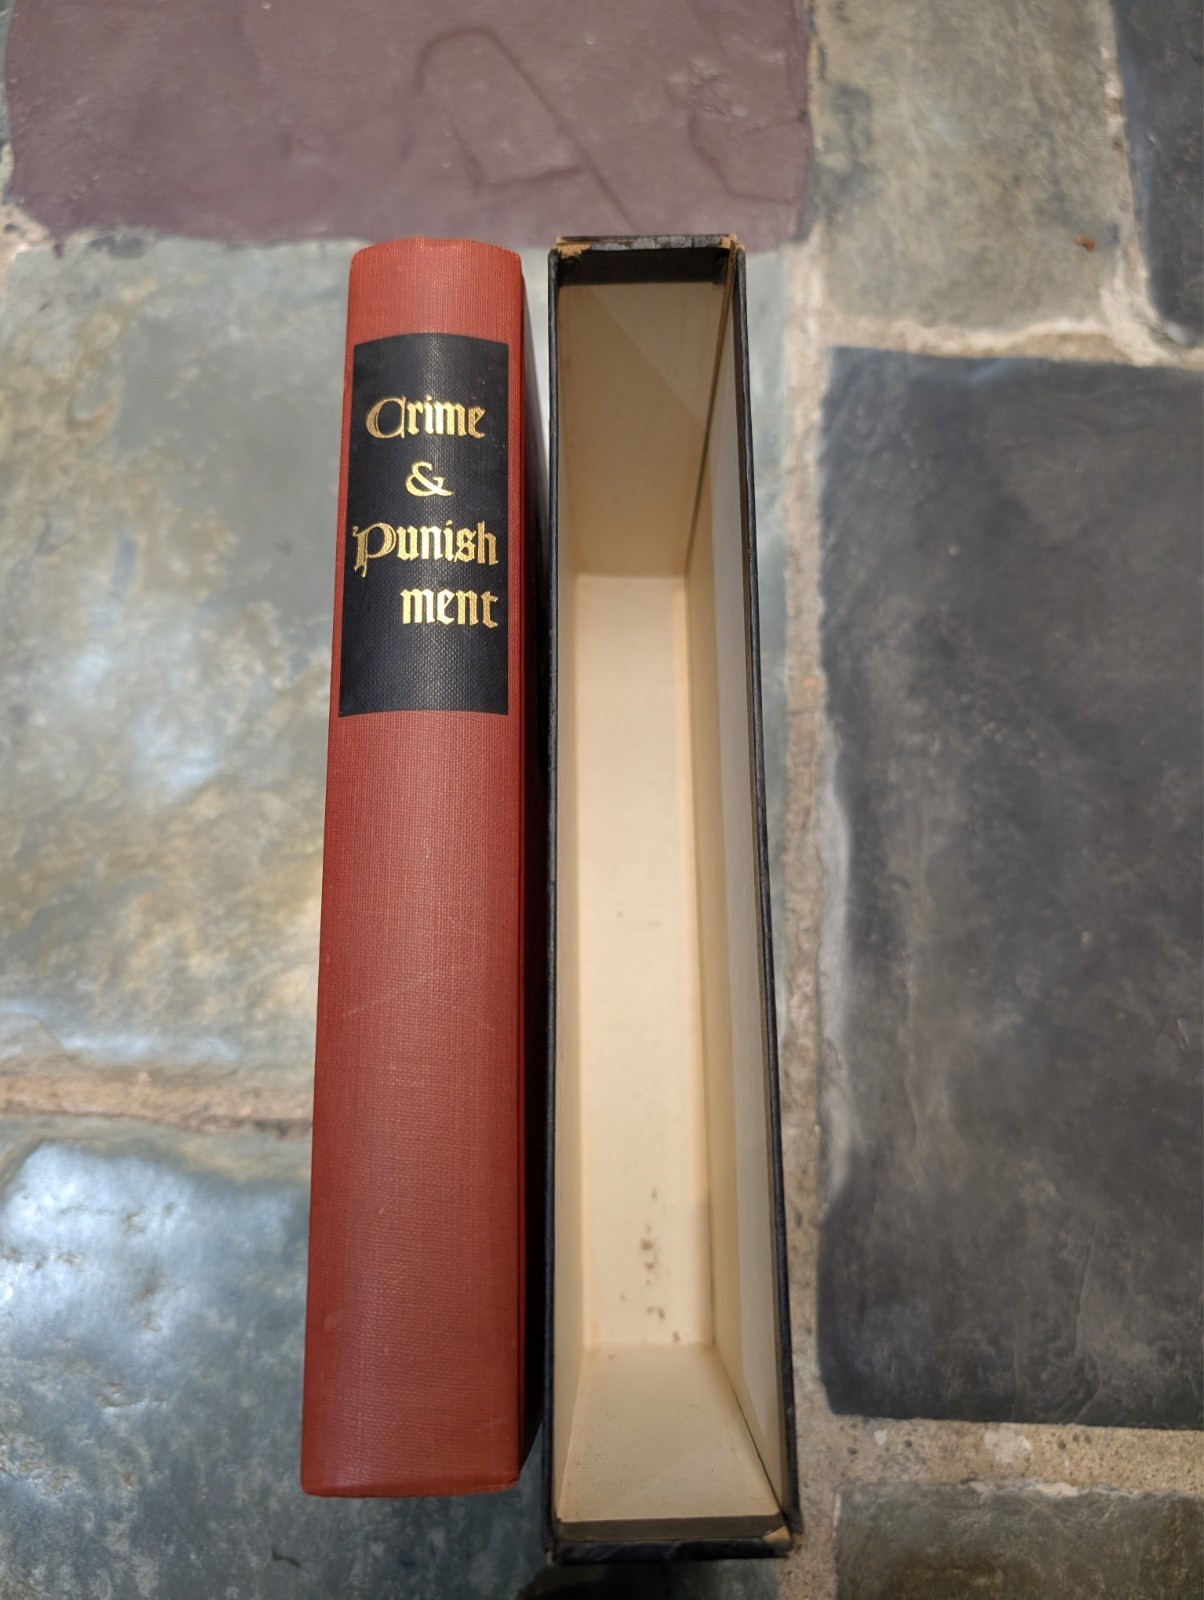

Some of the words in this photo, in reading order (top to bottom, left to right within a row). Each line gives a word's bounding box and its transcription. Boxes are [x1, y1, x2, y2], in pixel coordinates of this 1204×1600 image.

[365, 395, 486, 439] Crime
[406, 460, 454, 497] &
[352, 520, 499, 578] Punish
[400, 587, 499, 628] ment
